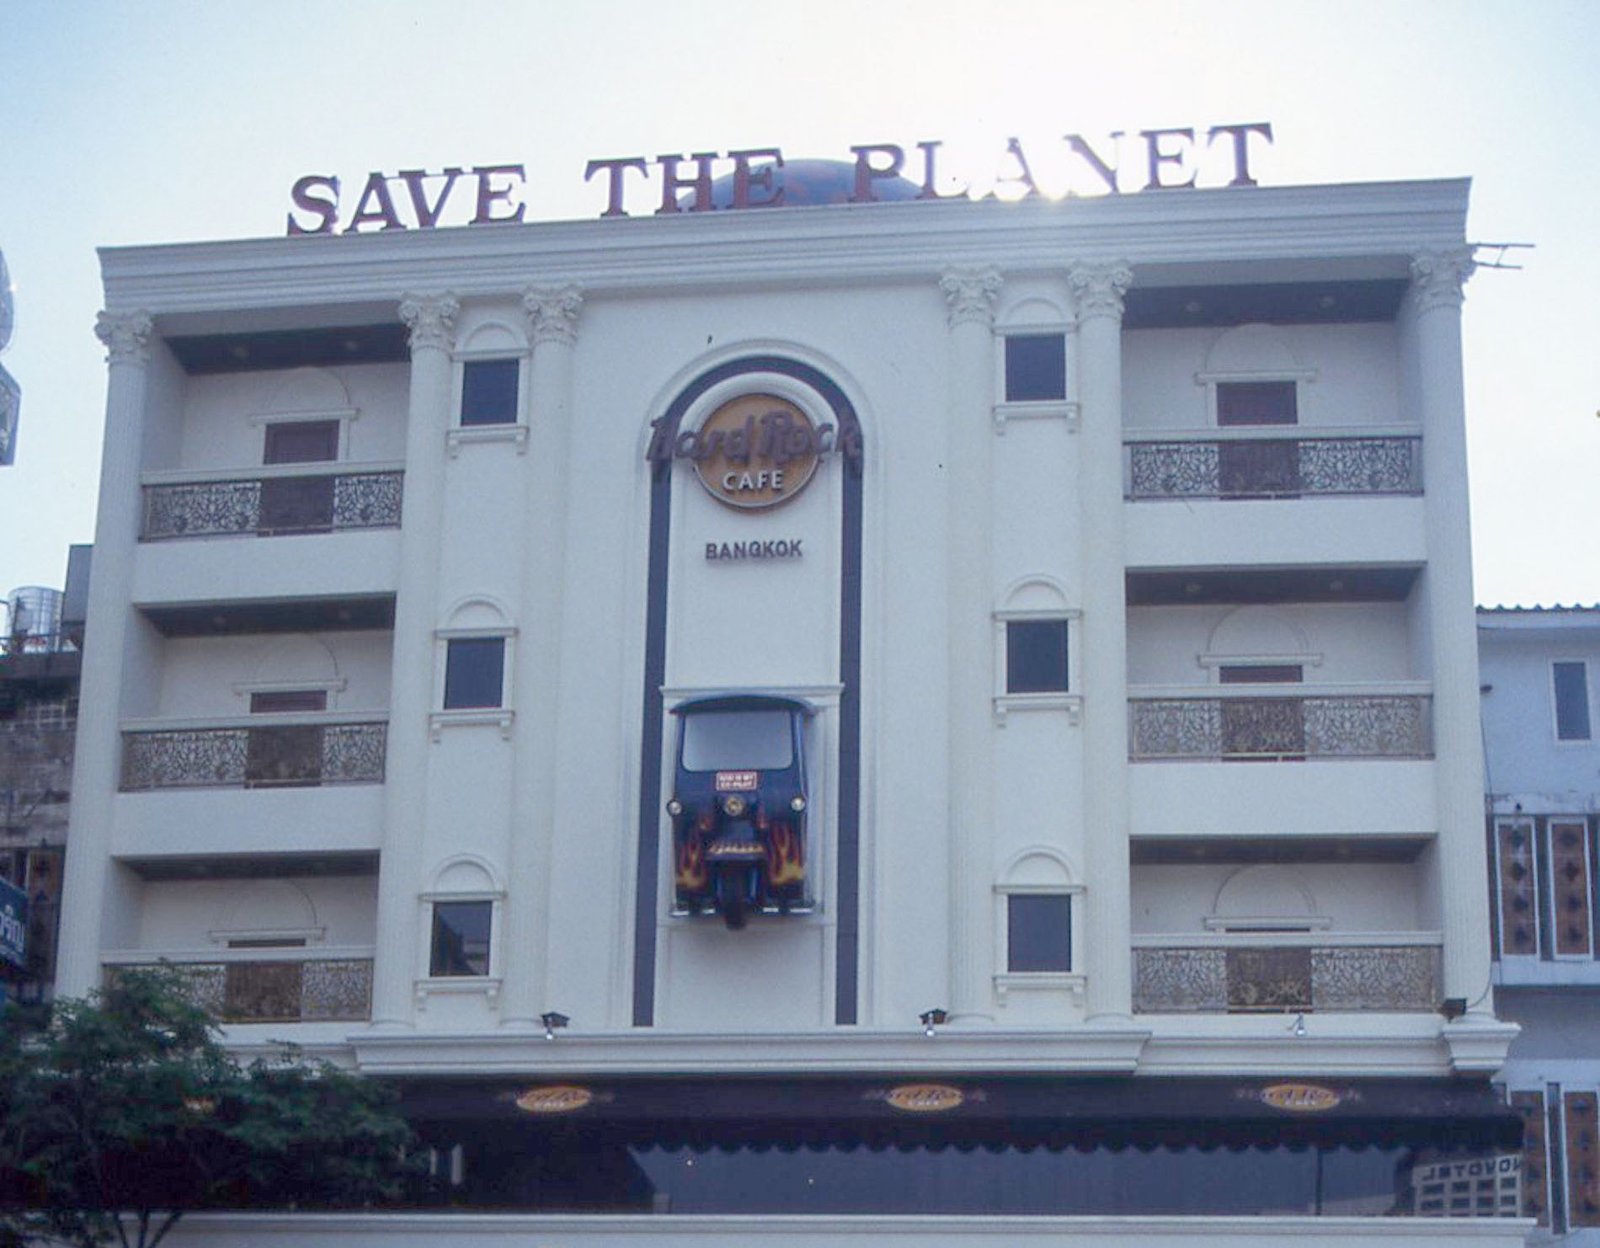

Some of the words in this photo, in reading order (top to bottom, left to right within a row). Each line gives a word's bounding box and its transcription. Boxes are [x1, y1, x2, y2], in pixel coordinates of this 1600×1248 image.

[287, 164, 527, 236] SAVE
[584, 148, 784, 218] THE
[848, 122, 1275, 201] PLANET
[722, 470, 785, 491] CAFE
[705, 540, 803, 560] BANGKOK
